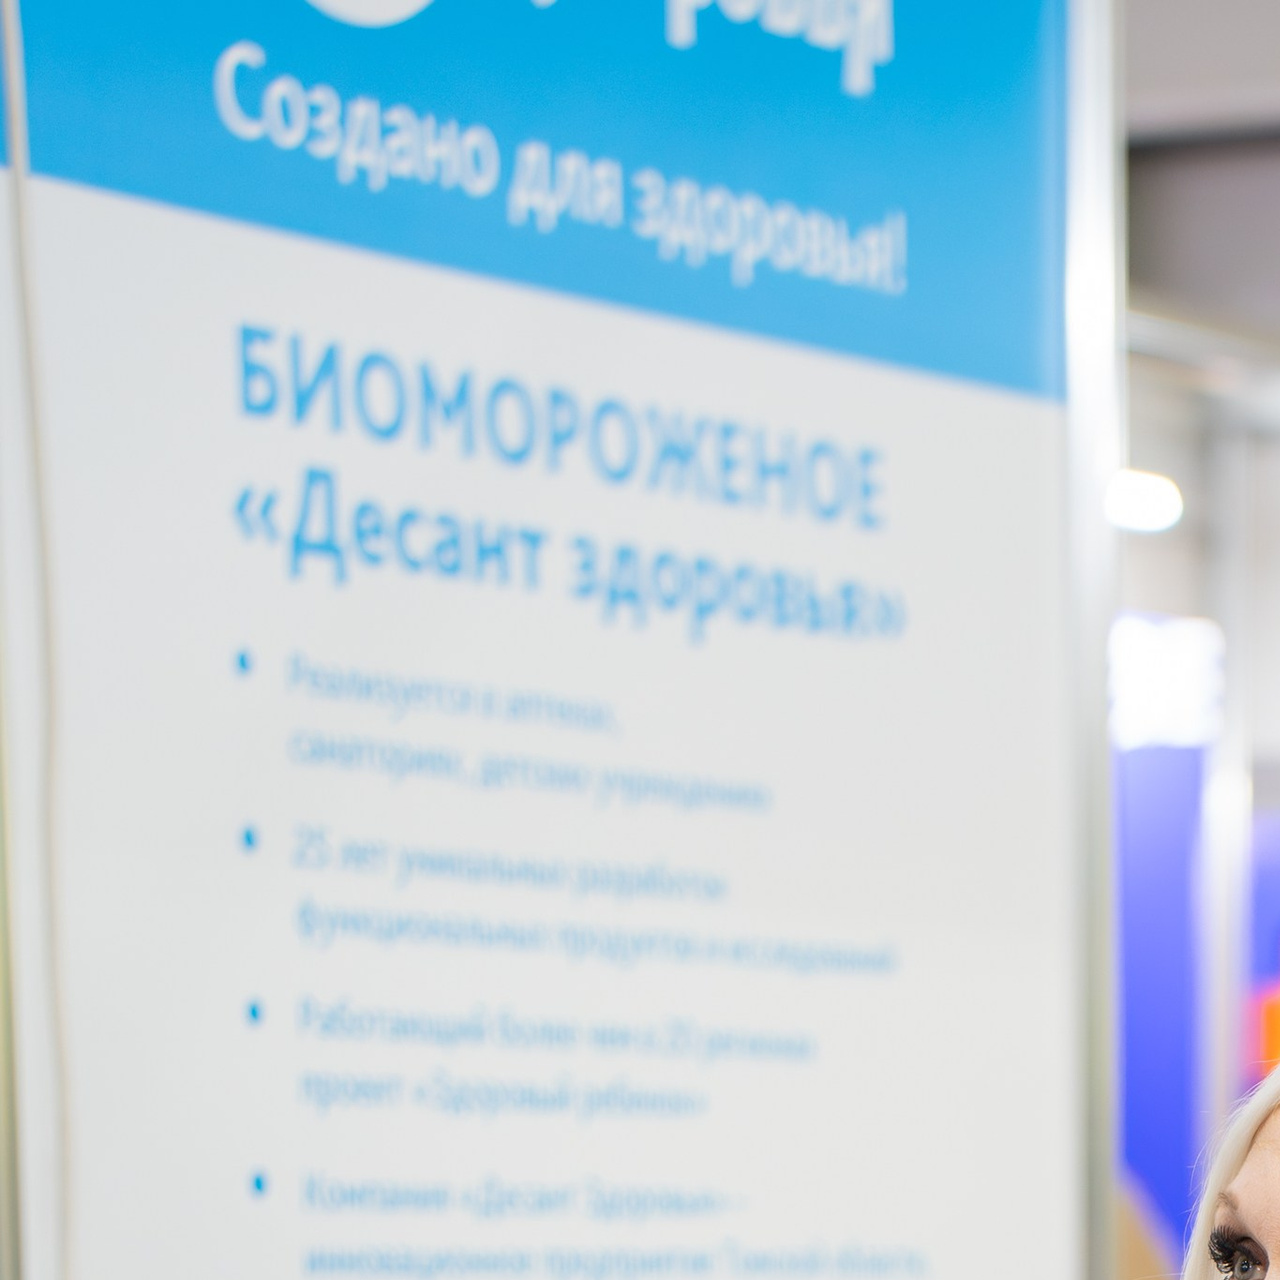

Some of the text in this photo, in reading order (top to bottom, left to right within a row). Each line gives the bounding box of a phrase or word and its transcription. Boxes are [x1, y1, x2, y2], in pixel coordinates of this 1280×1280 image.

[213, 42, 909, 295] Создано для здоровья!
[234, 322, 890, 532] БИОМОРОЖЕНОЕ
[232, 465, 910, 645] «Десант здоровья»
